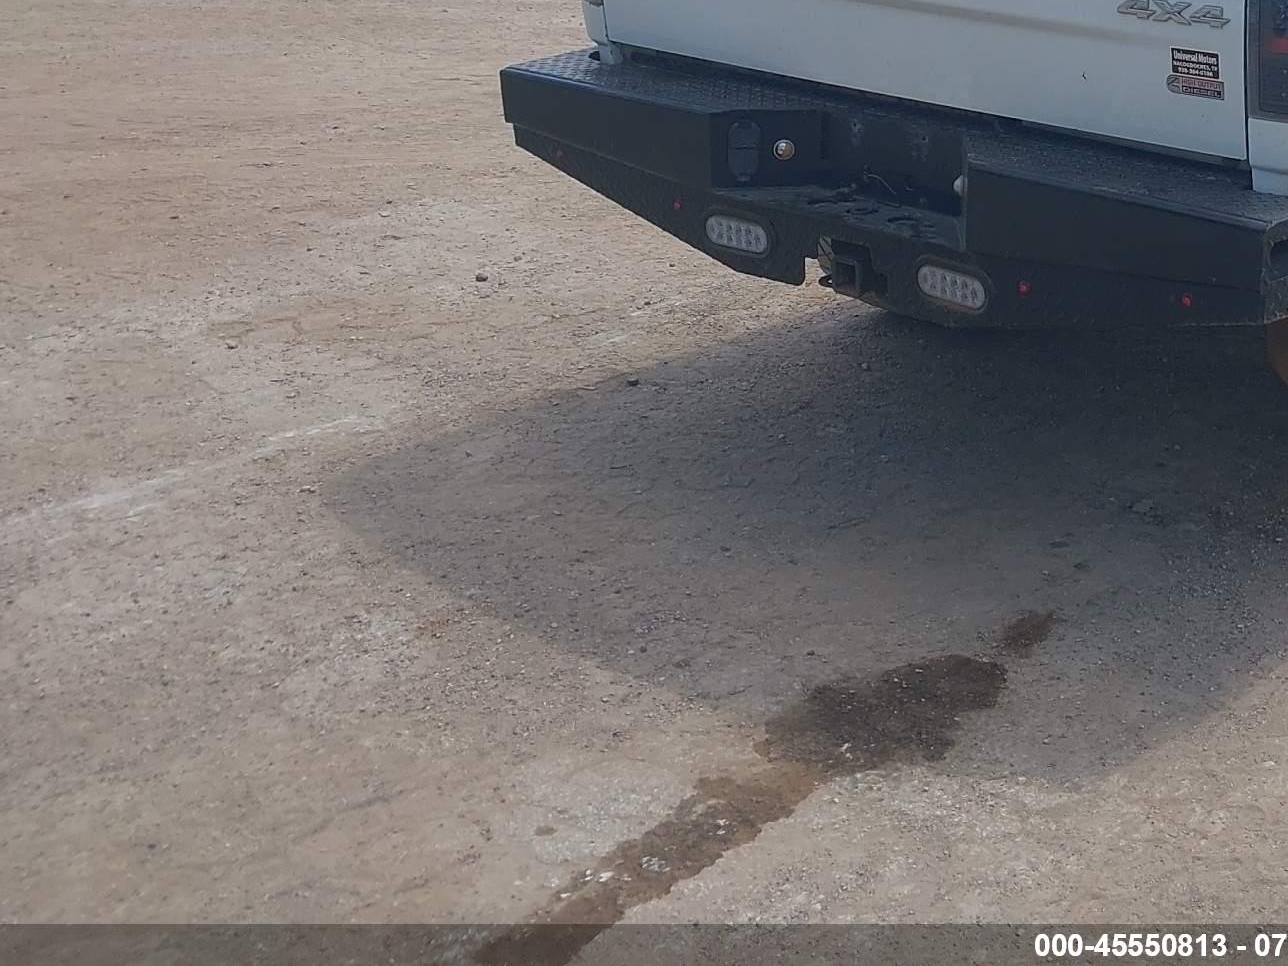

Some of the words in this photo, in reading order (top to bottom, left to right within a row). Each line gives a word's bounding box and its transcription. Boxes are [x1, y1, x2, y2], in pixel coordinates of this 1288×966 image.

[1173, 50, 1198, 62] Universal
[1198, 53, 1217, 64] Motors
[1197, 79, 1221, 91] OUTPUT
[1182, 86, 1221, 98] DIESEL
